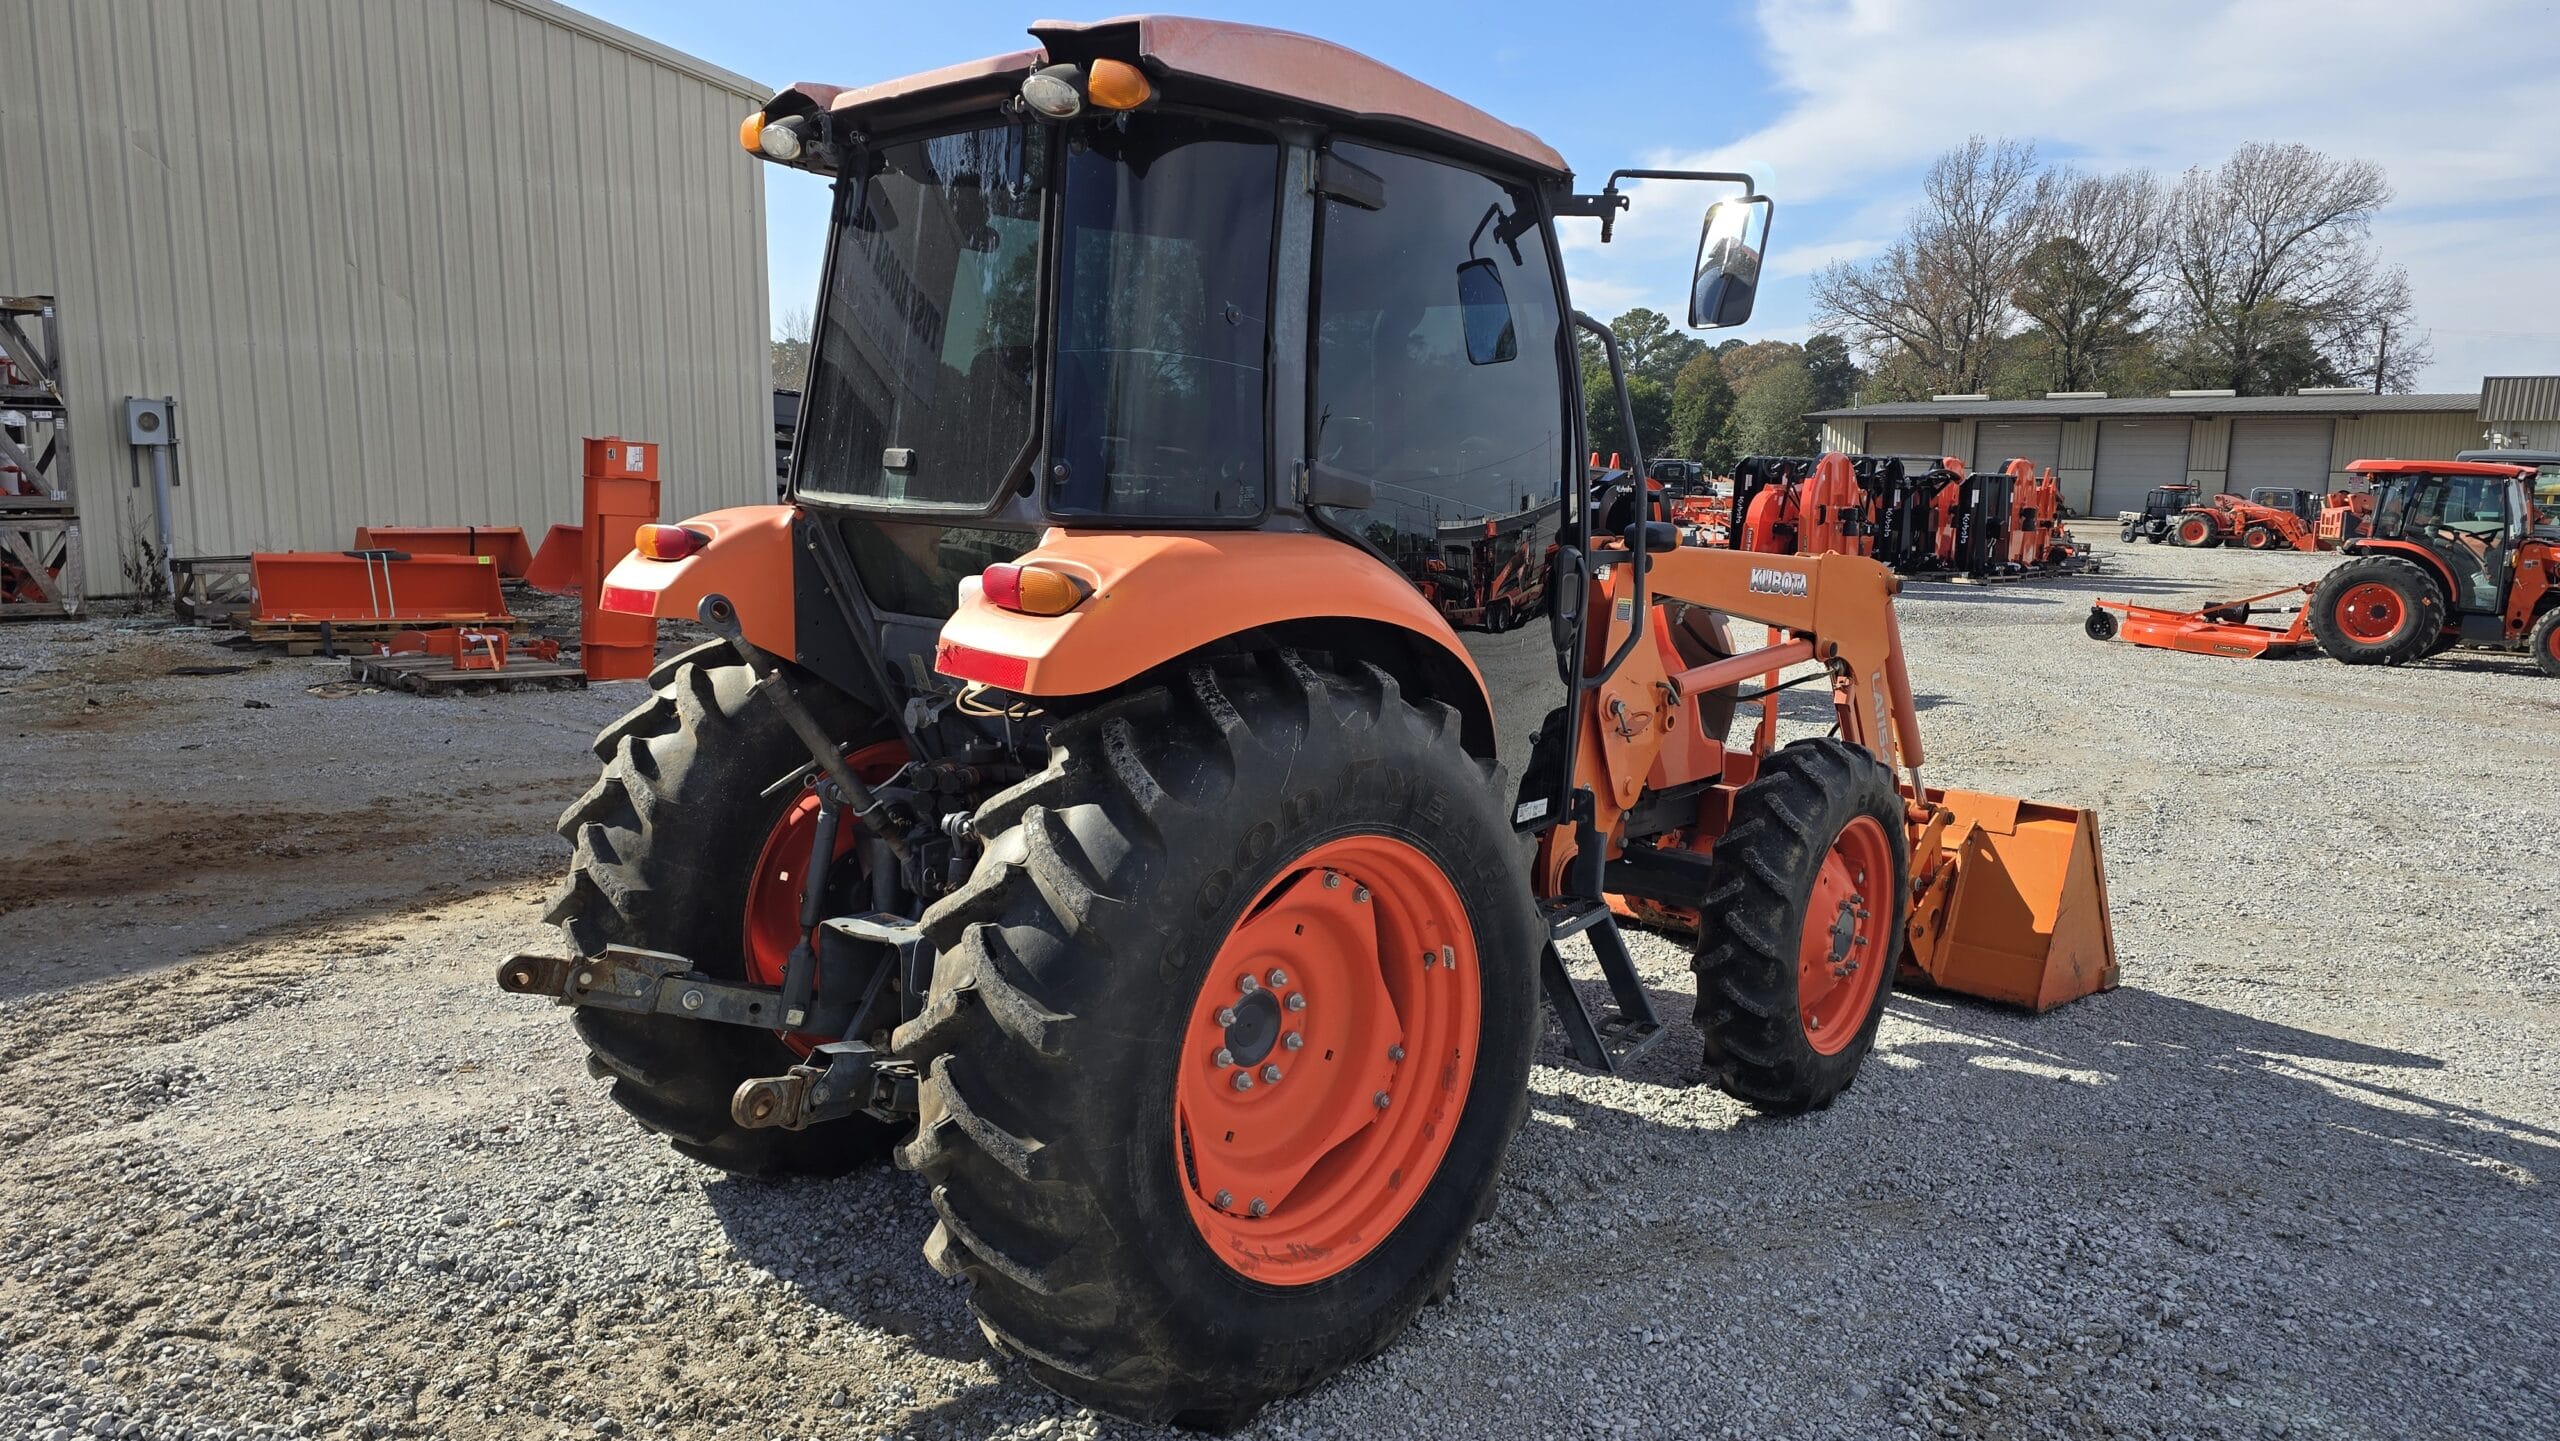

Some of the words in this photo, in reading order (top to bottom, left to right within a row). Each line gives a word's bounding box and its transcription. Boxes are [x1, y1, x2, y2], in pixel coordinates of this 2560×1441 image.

[1735, 496, 1745, 524] Kubota
[1884, 507, 1894, 538] Kubota
[1960, 513, 1971, 545] Kubota
[1749, 568, 1808, 597] KUBOTA
[1159, 757, 1509, 985] GOODYEAR
